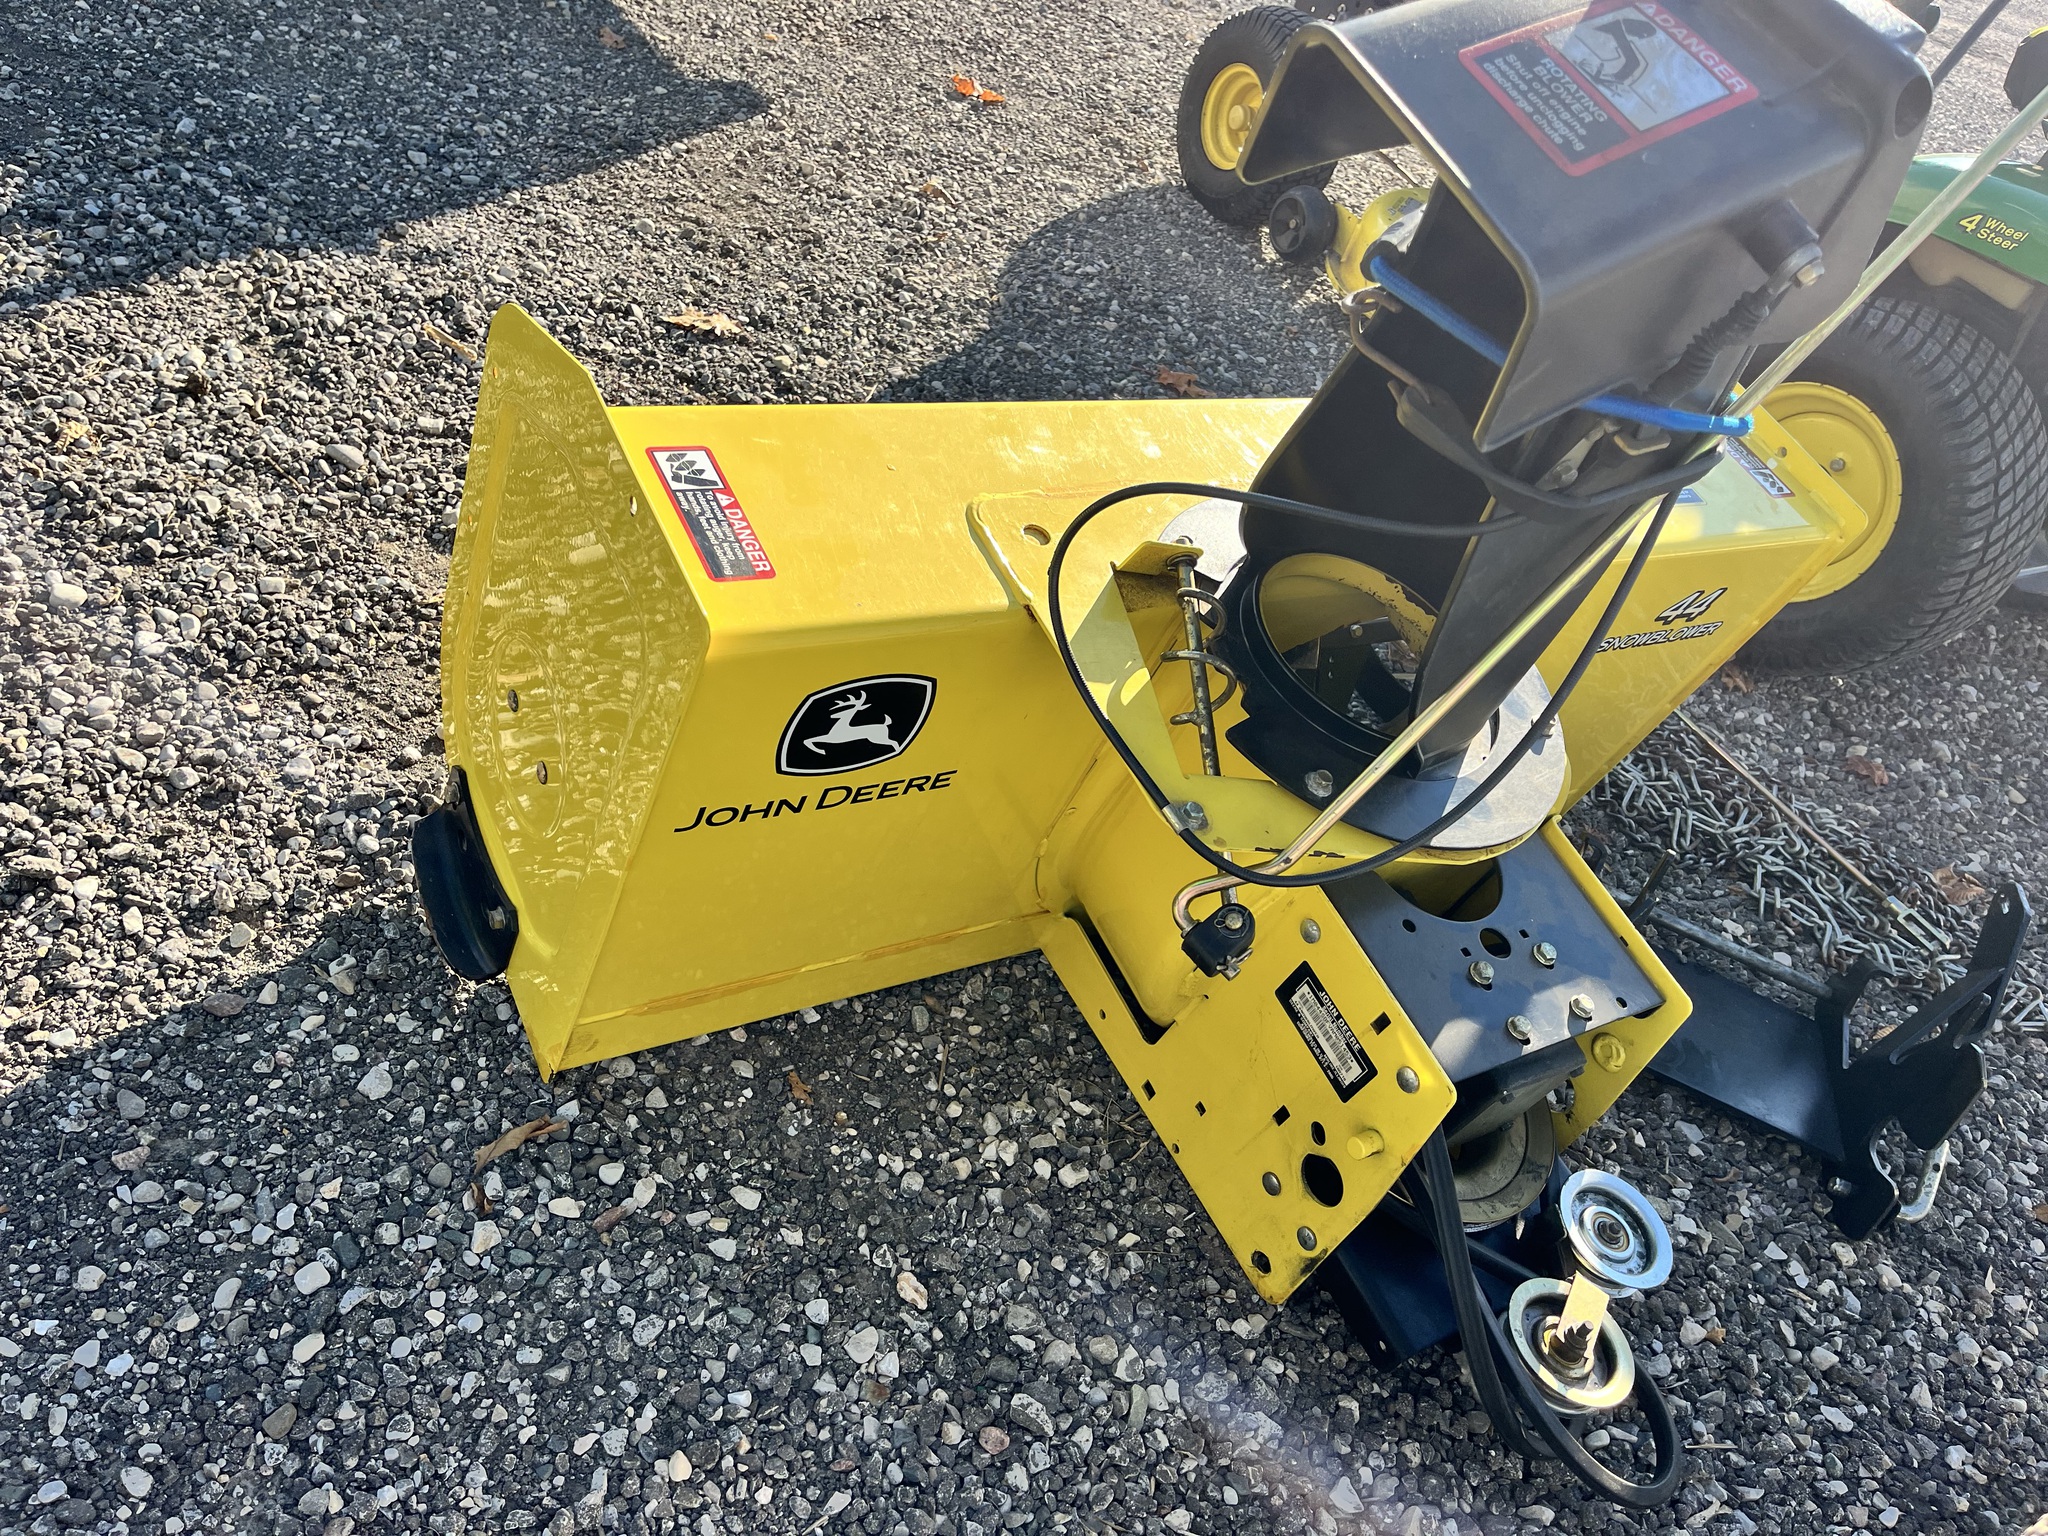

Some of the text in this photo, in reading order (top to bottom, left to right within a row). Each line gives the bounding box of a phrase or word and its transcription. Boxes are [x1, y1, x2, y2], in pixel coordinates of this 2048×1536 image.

[1652, 12, 1748, 93] DANGER
[1483, 62, 1564, 145] discharge chute
[1494, 57, 1585, 151] before unclogging
[1505, 54, 1587, 136] Shut off engine
[1533, 66, 1594, 124] BLOWER
[1540, 58, 1608, 122] ROTATING
[1958, 213, 2029, 241] 4 Wheel
[1976, 228, 2019, 250] Steer
[695, 491, 713, 518] rotating
[721, 542, 735, 560] keep
[698, 515, 707, 530] feet
[705, 530, 716, 545] and
[713, 545, 733, 575] clothing
[705, 490, 745, 560] To avoid injury from
[724, 508, 771, 572] DANGER
[1596, 621, 1723, 653] SNOWBLOWER
[1654, 587, 1728, 625] 44
[673, 770, 958, 833] JOHN DEERE
[1319, 991, 1339, 1017] JOHN
[1338, 1018, 1361, 1052] DEERE
